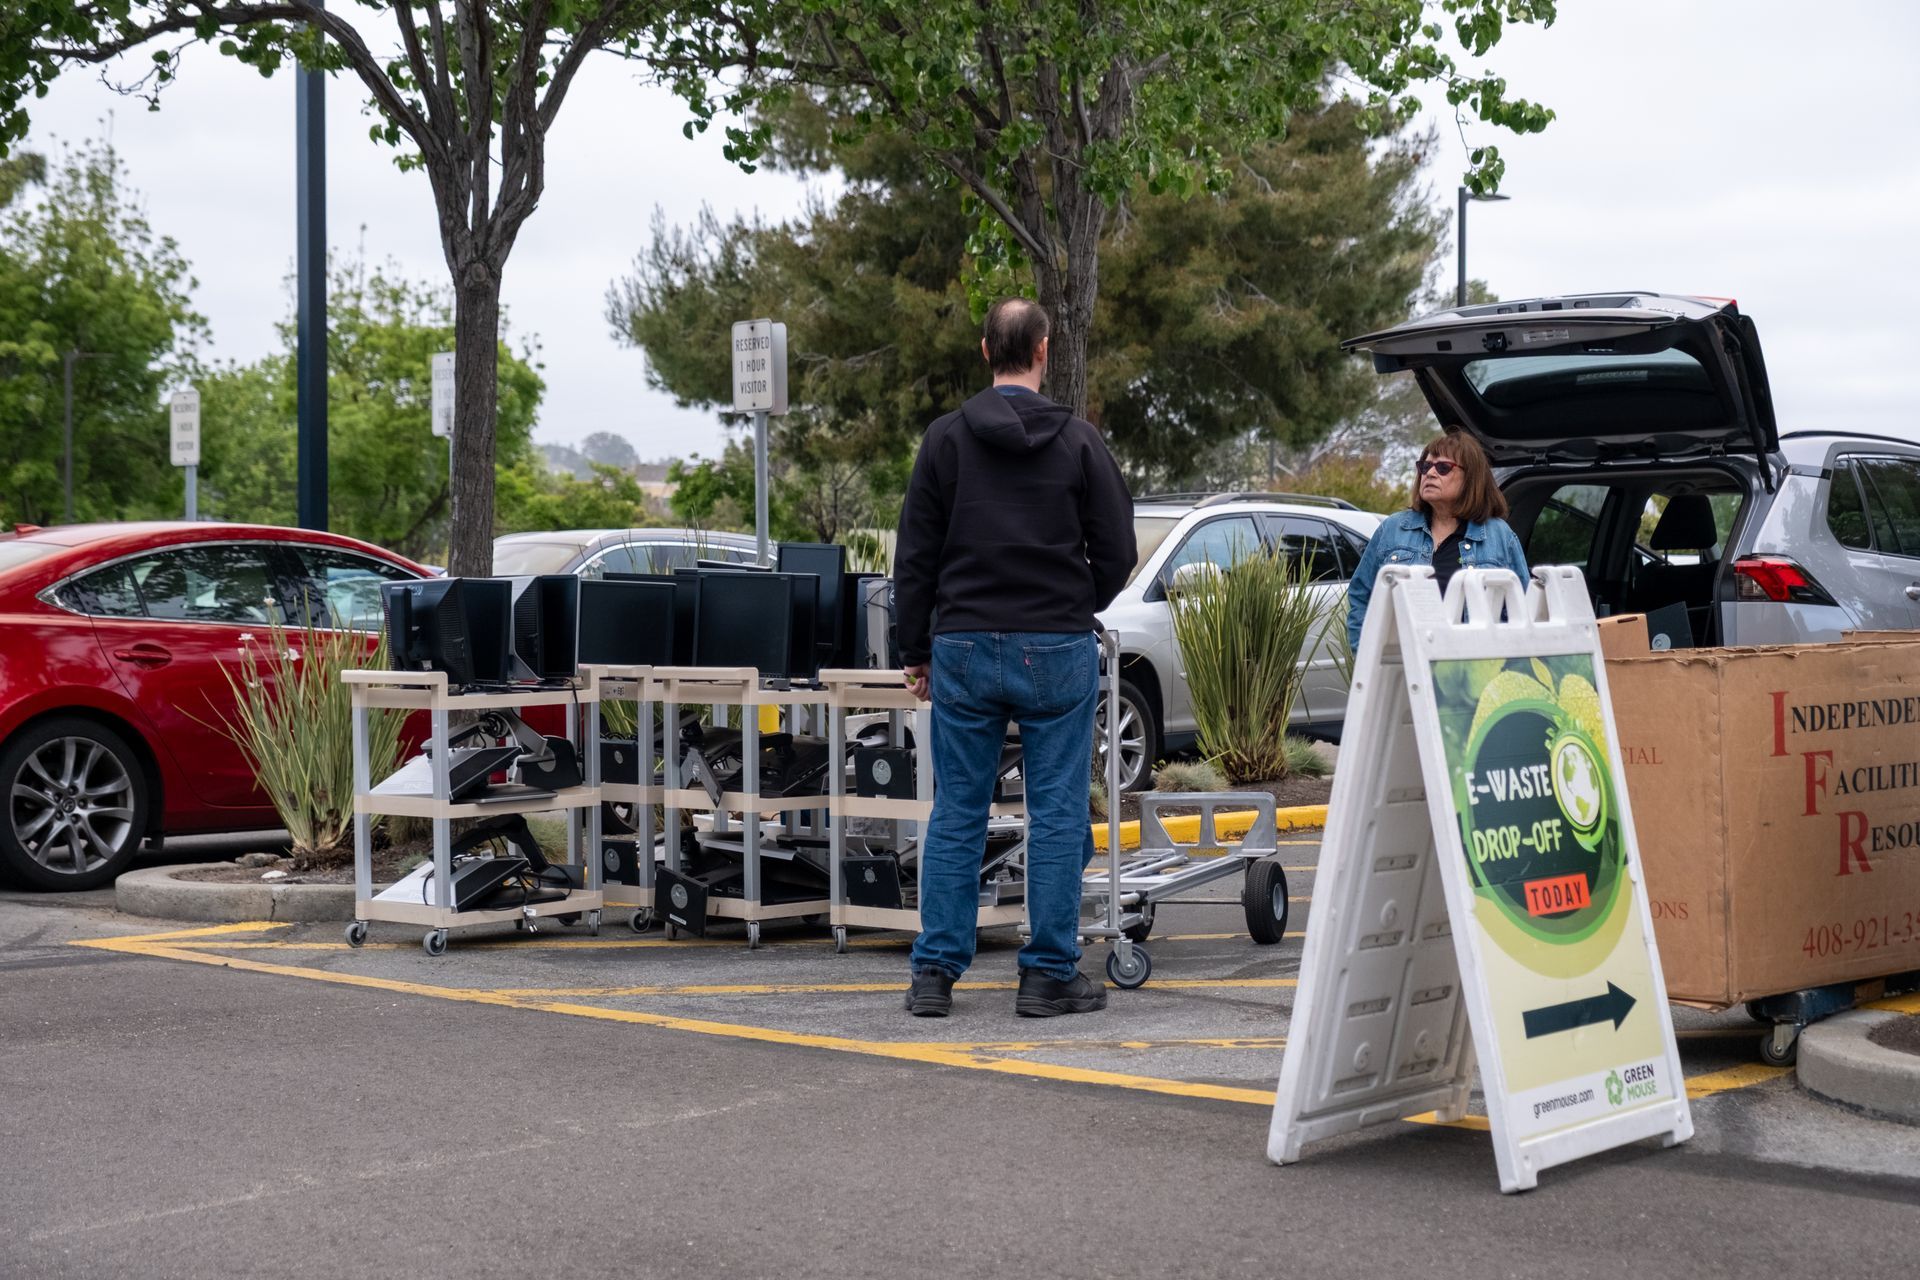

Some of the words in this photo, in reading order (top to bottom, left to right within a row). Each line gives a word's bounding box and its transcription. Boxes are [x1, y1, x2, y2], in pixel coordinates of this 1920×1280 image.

[736, 336, 770, 351] RESERVED
[747, 359, 766, 373] HOUR
[740, 380, 767, 394] VISITOR
[1768, 691, 1920, 757] INDEPENDE
[1465, 764, 1552, 806] E-WASTE
[1472, 819, 1563, 864] DROP-OFF
[1530, 880, 1583, 910] TODAY
[1624, 1063, 1655, 1084] GREEN
[1627, 1080, 1657, 1101] MOUSE
[1533, 1088, 1595, 1119] greenmouse.com
